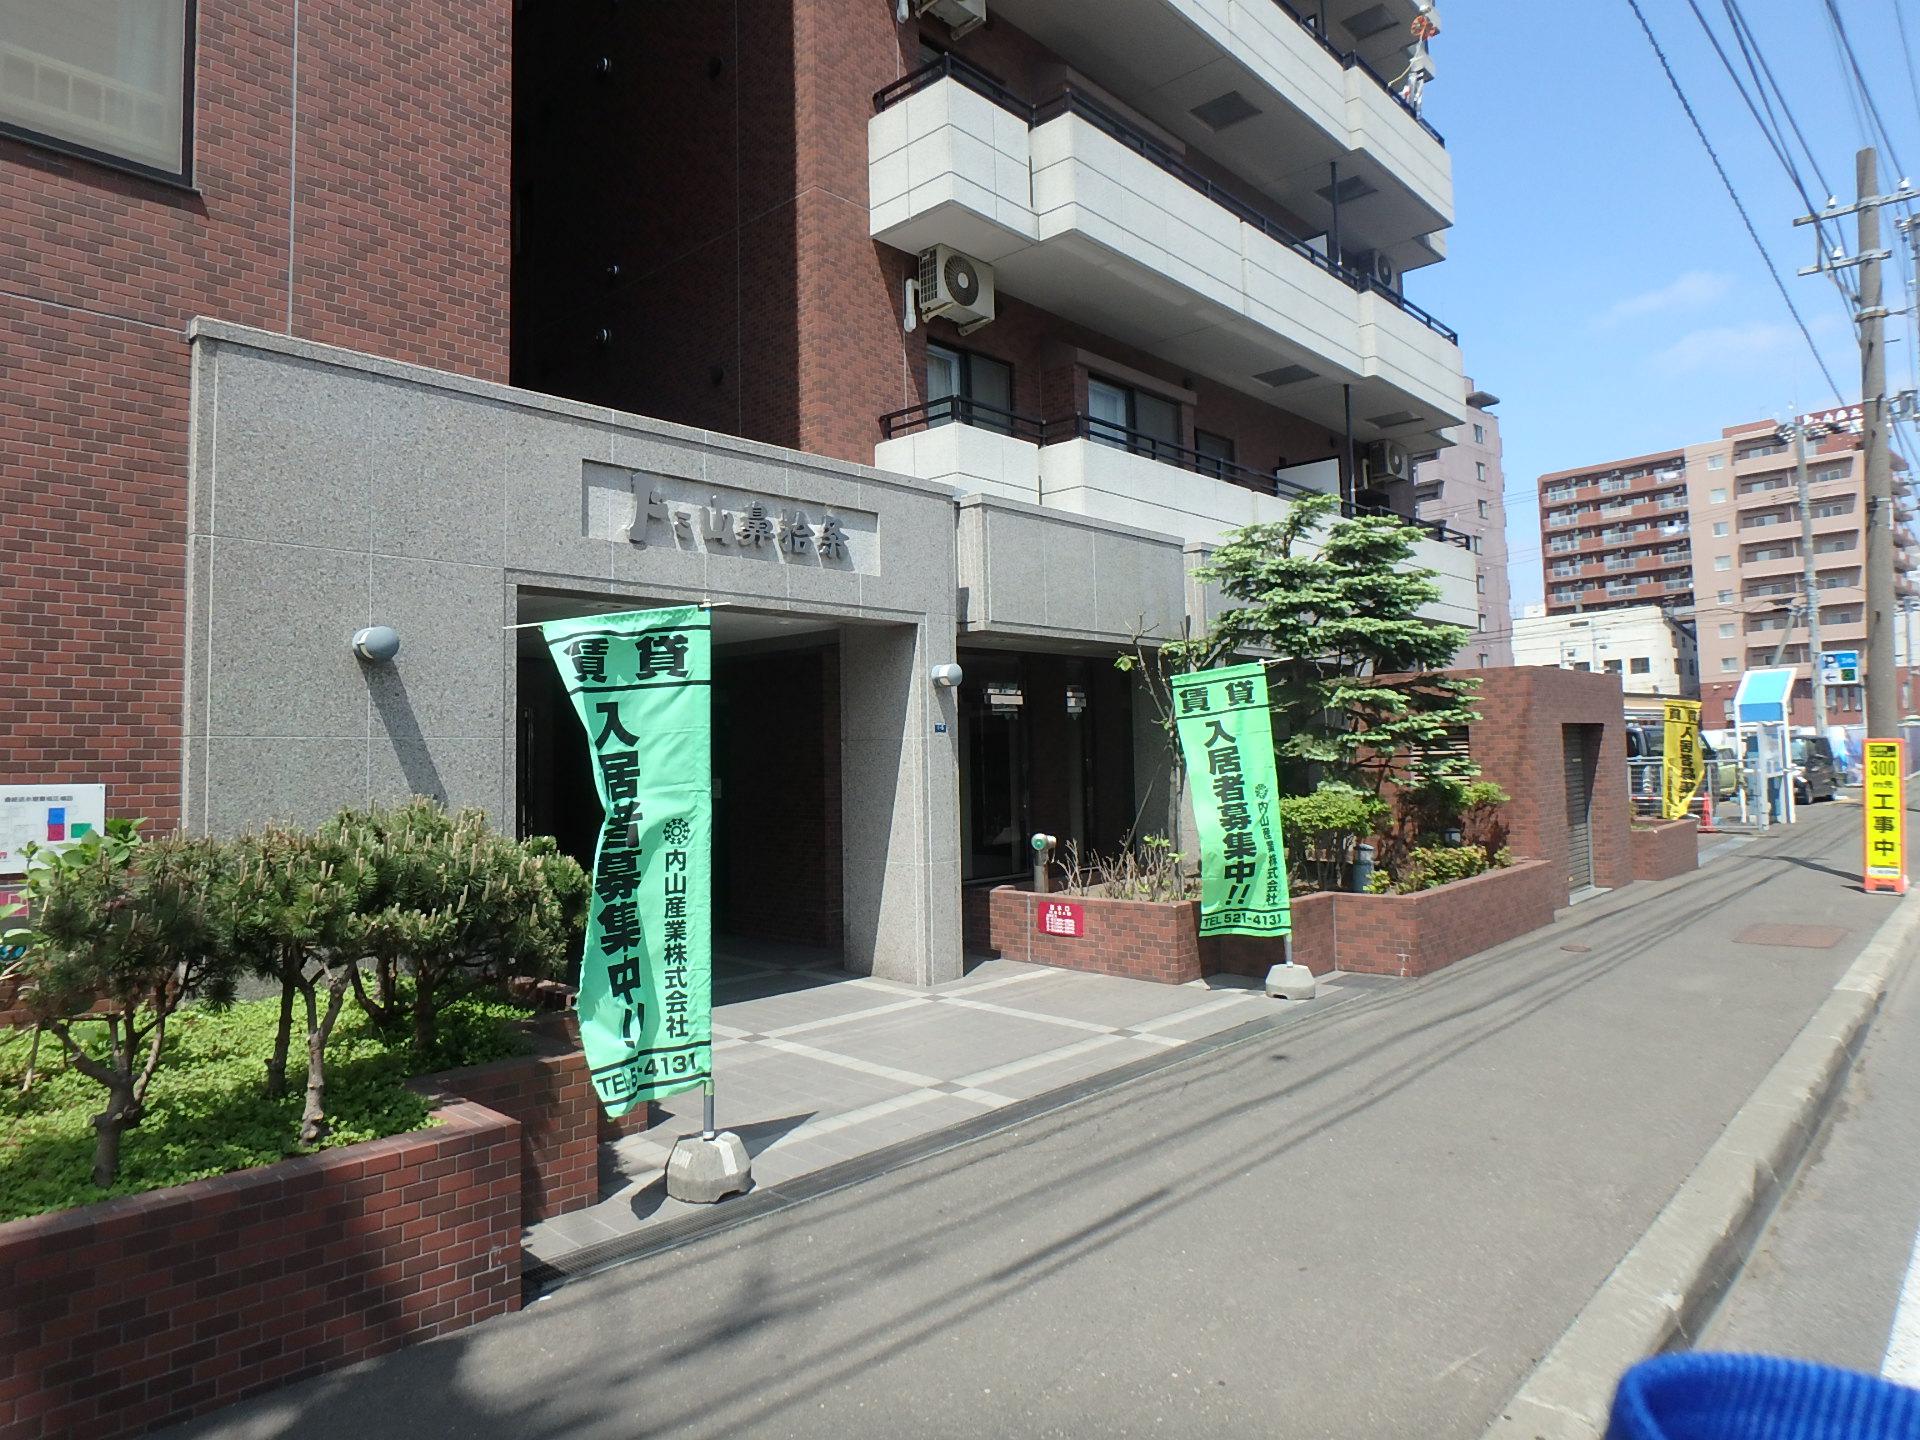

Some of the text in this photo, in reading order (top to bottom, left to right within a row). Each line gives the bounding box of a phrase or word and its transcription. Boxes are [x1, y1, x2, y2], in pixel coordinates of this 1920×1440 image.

[563, 633, 689, 684] 賃貸
[1179, 679, 1256, 715] 賃貸
[1870, 760, 1896, 776] 300
[1204, 719, 1257, 906] 入居者募集中!!
[1872, 793, 1895, 857] 工事中
[664, 848, 689, 1039] 内山産業株式会社
[1203, 912, 1282, 927] TEL 521-4131
